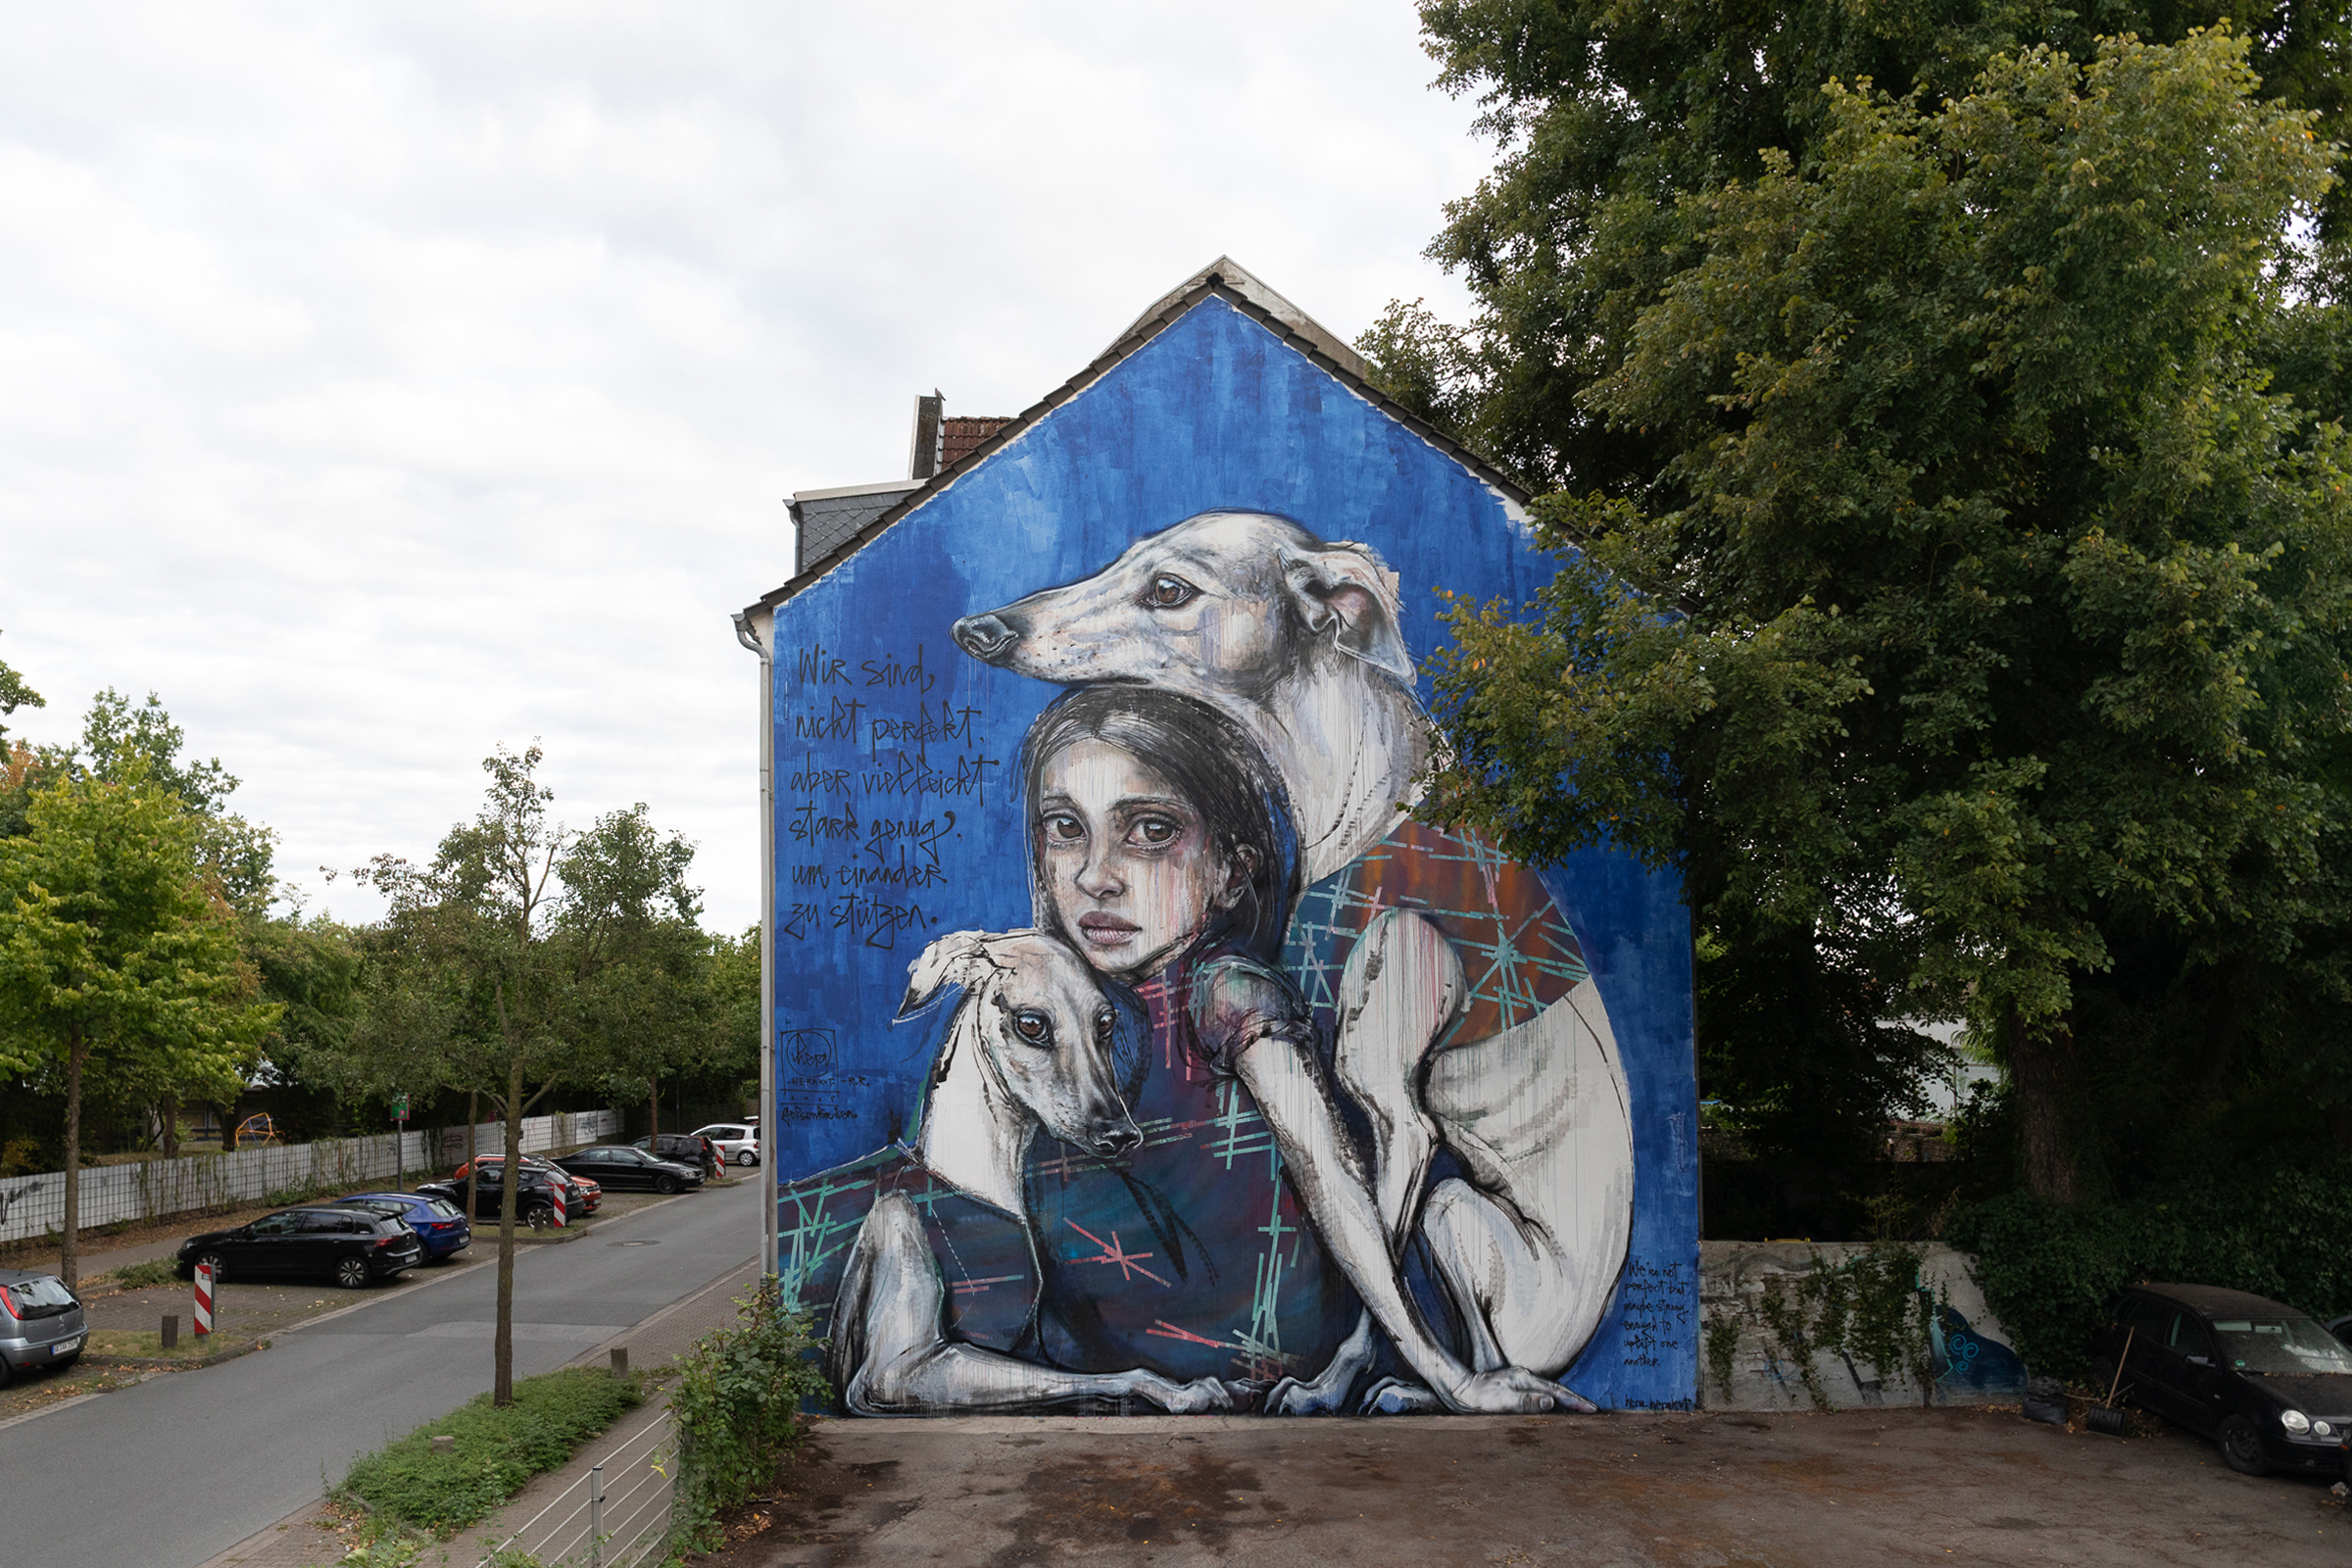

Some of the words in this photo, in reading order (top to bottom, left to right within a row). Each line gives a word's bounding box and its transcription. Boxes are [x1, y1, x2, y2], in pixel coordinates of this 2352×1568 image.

[796, 696, 866, 744] nicht
[862, 751, 1000, 807] vielleicht
[792, 864, 830, 889] um
[784, 903, 820, 941] zu
[830, 892, 938, 950] stützen.
[1662, 1260, 1683, 1280] not
[1624, 1279, 1667, 1299] perfect
[1667, 1280, 1688, 1297] but
[1623, 1298, 1654, 1319] maybe
[1656, 1299, 1690, 1325] strong
[1620, 1316, 1658, 1339] enough
[1659, 1317, 1672, 1335] to
[1623, 1335, 1656, 1354] uplift
[1660, 1340, 1679, 1350] one
